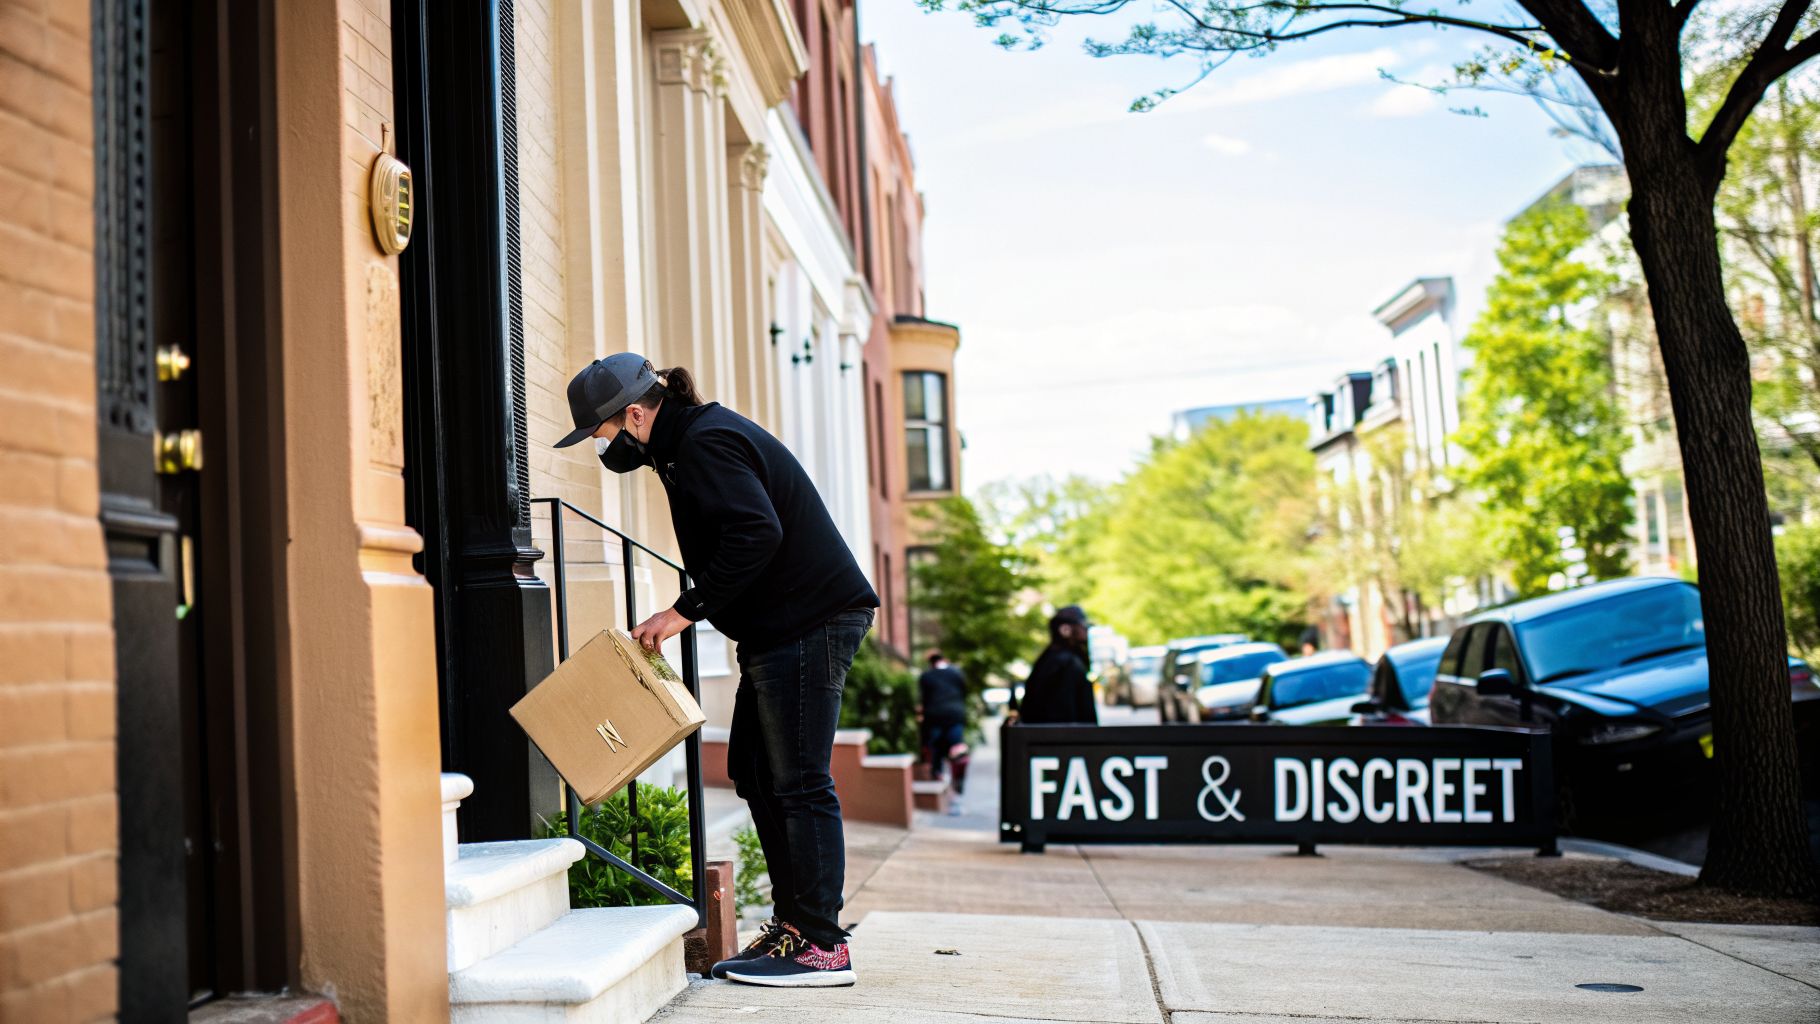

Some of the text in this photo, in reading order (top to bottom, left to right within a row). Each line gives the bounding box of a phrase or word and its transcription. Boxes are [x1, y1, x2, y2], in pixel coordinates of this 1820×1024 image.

[1030, 755, 1523, 823] FAST & DISCREET
